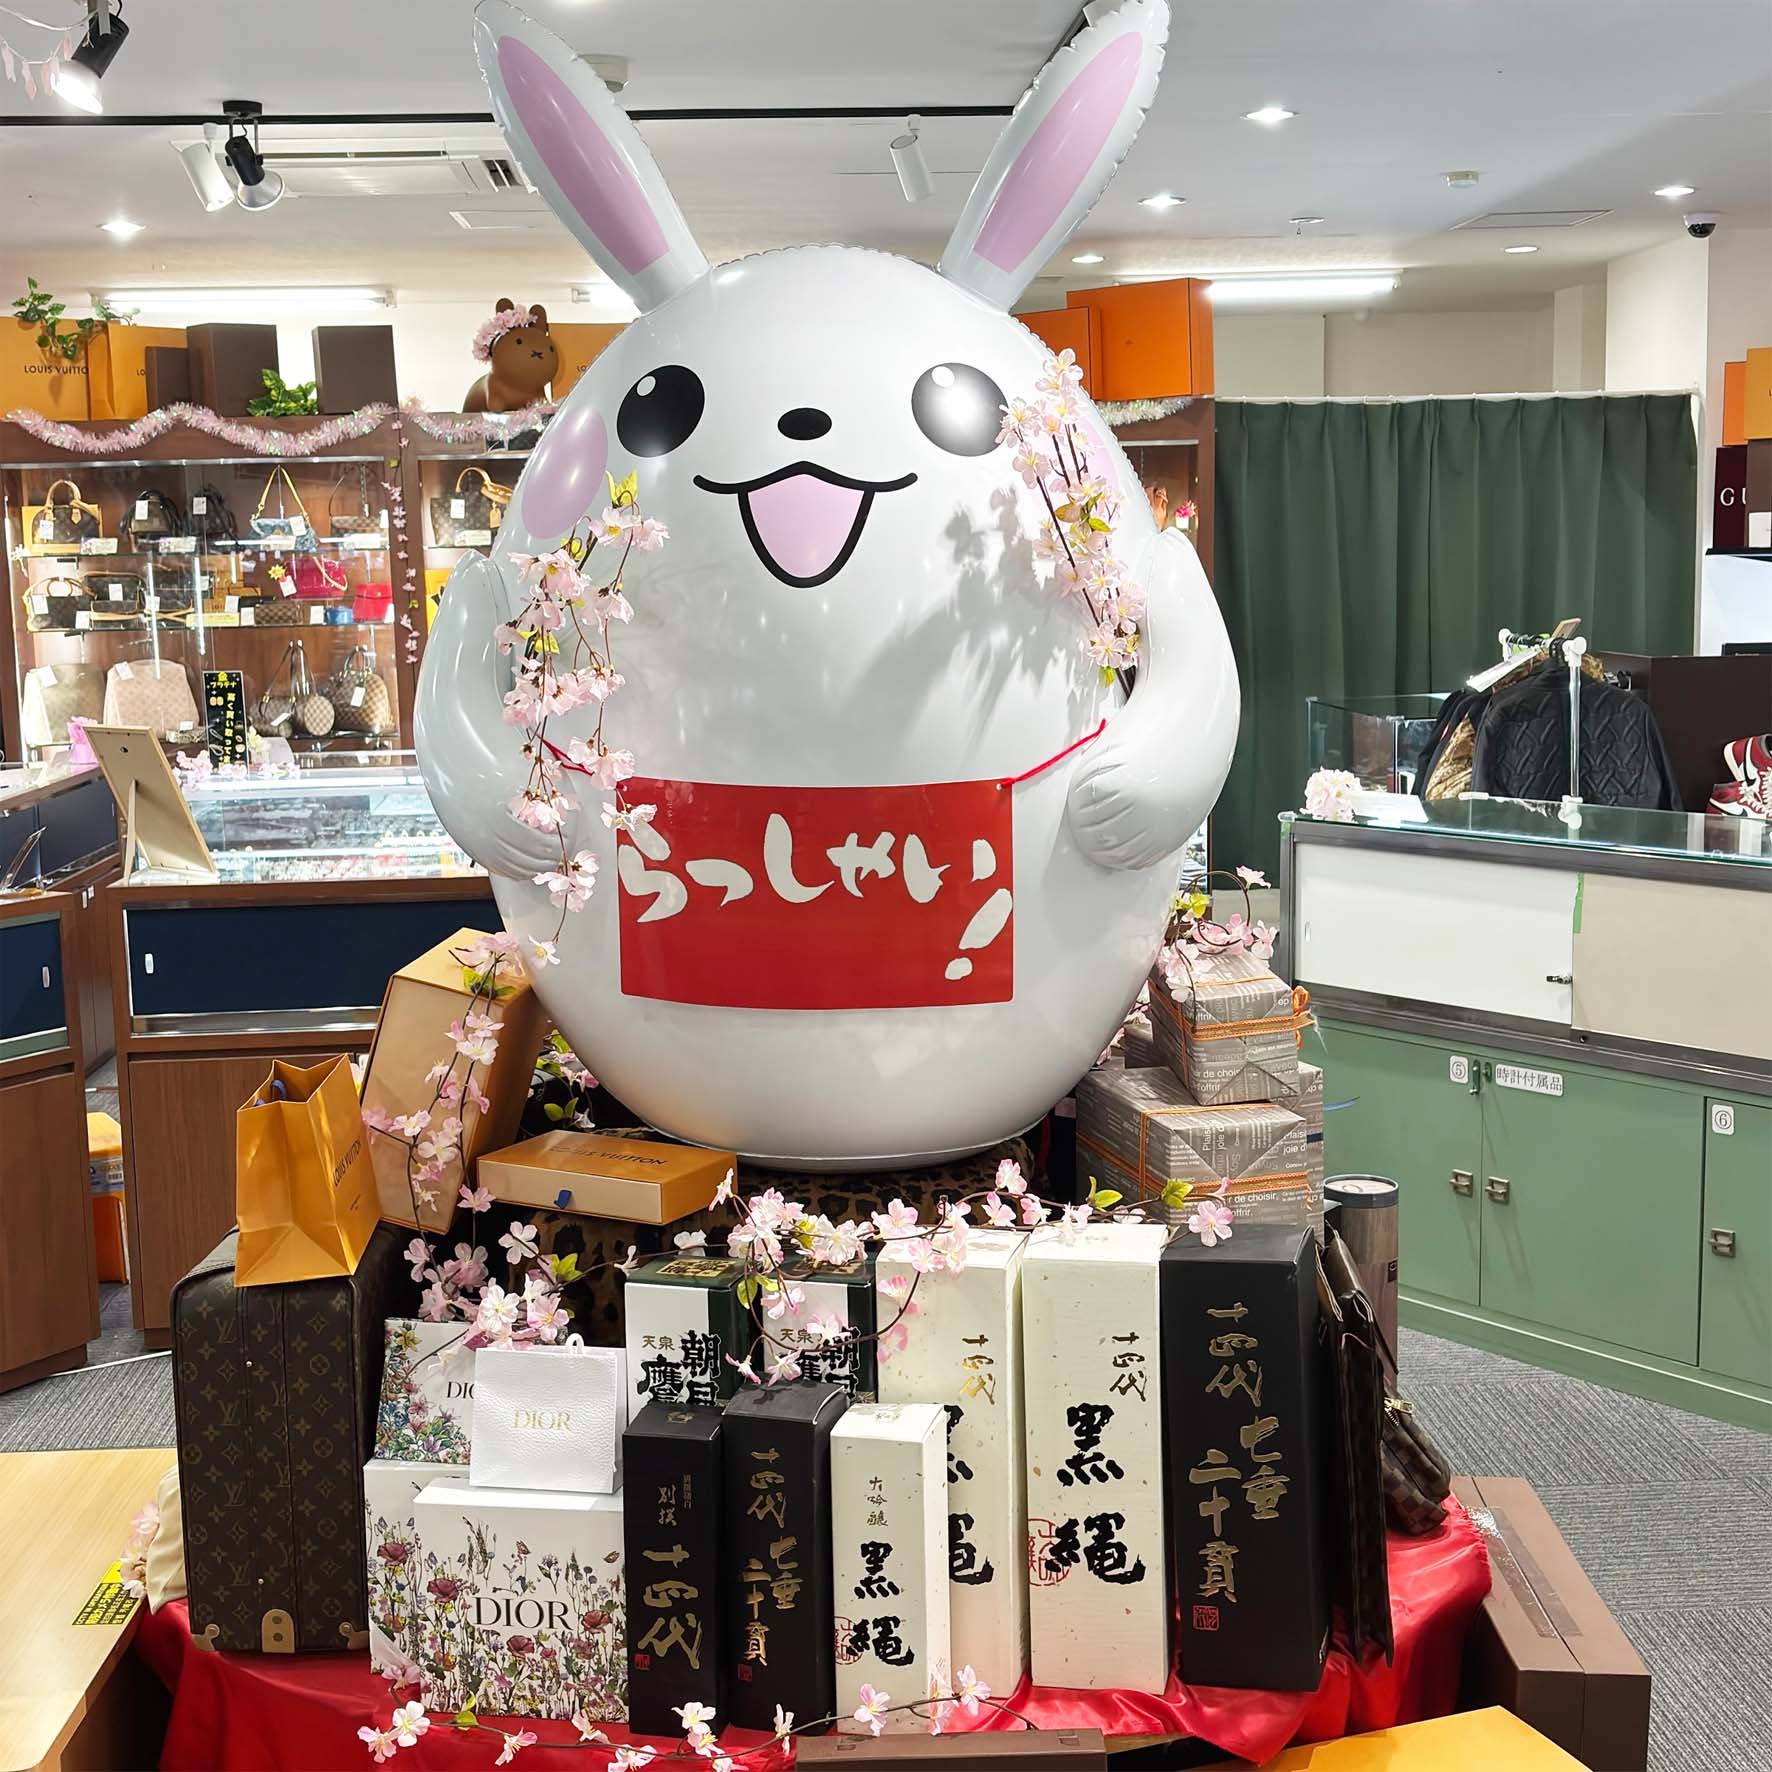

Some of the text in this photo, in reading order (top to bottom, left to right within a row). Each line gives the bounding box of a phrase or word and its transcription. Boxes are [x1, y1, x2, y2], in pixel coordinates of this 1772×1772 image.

[24, 365, 52, 374] LOUIS
[1496, 1067, 1562, 1092] 時計付属品
[599, 1152, 669, 1166] VUITTON
[1283, 1145, 1298, 1155] joie
[642, 1335, 675, 1351] 天泉
[1205, 1302, 1262, 1408] 十四代
[1109, 1332, 1147, 1402] 十四代
[513, 1408, 572, 1432] DIOR
[748, 1448, 787, 1528] 十四代
[474, 1597, 574, 1631] DIOR
[638, 1544, 702, 1670] 十四代
